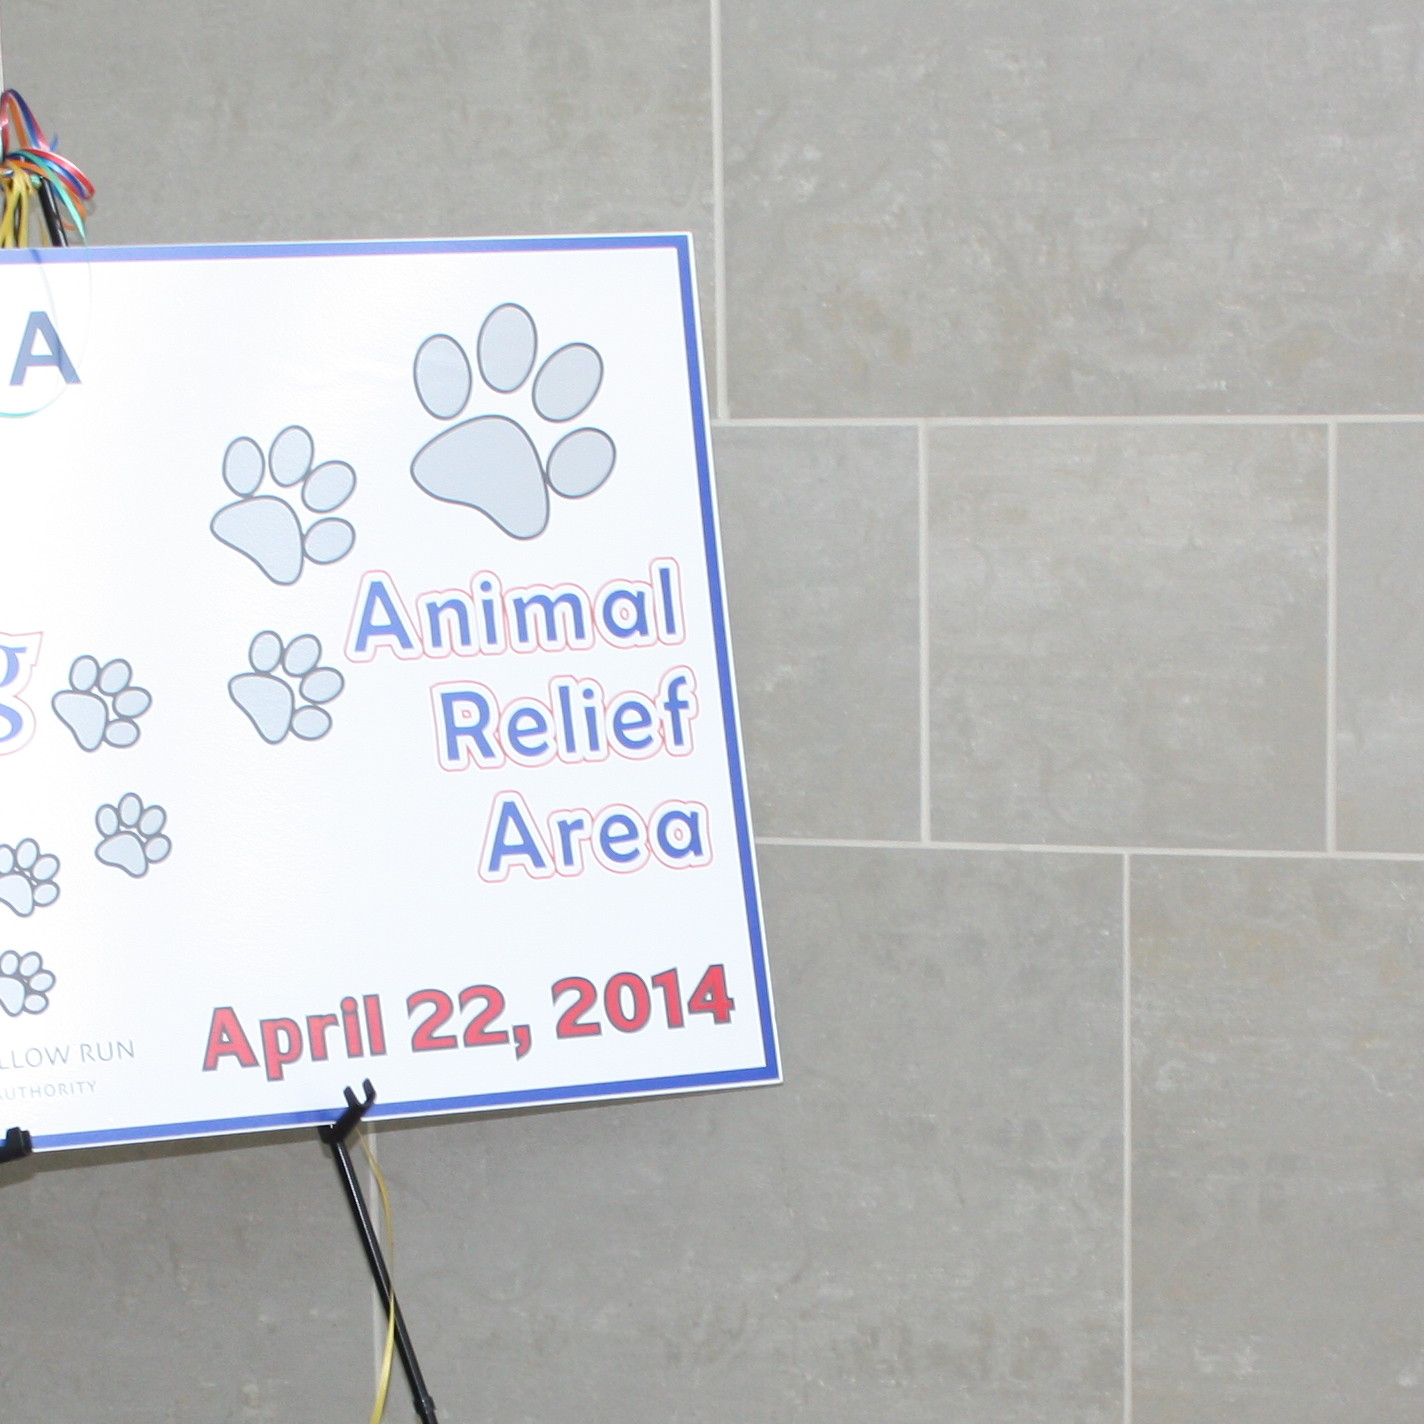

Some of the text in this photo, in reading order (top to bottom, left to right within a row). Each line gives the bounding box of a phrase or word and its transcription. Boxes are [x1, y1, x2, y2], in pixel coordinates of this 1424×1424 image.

[350, 562, 681, 657] Animal
[436, 671, 694, 765] Relief
[484, 796, 708, 877] Area
[79, 1039, 136, 1064] RUN
[201, 963, 736, 1082] April 22, 2014
